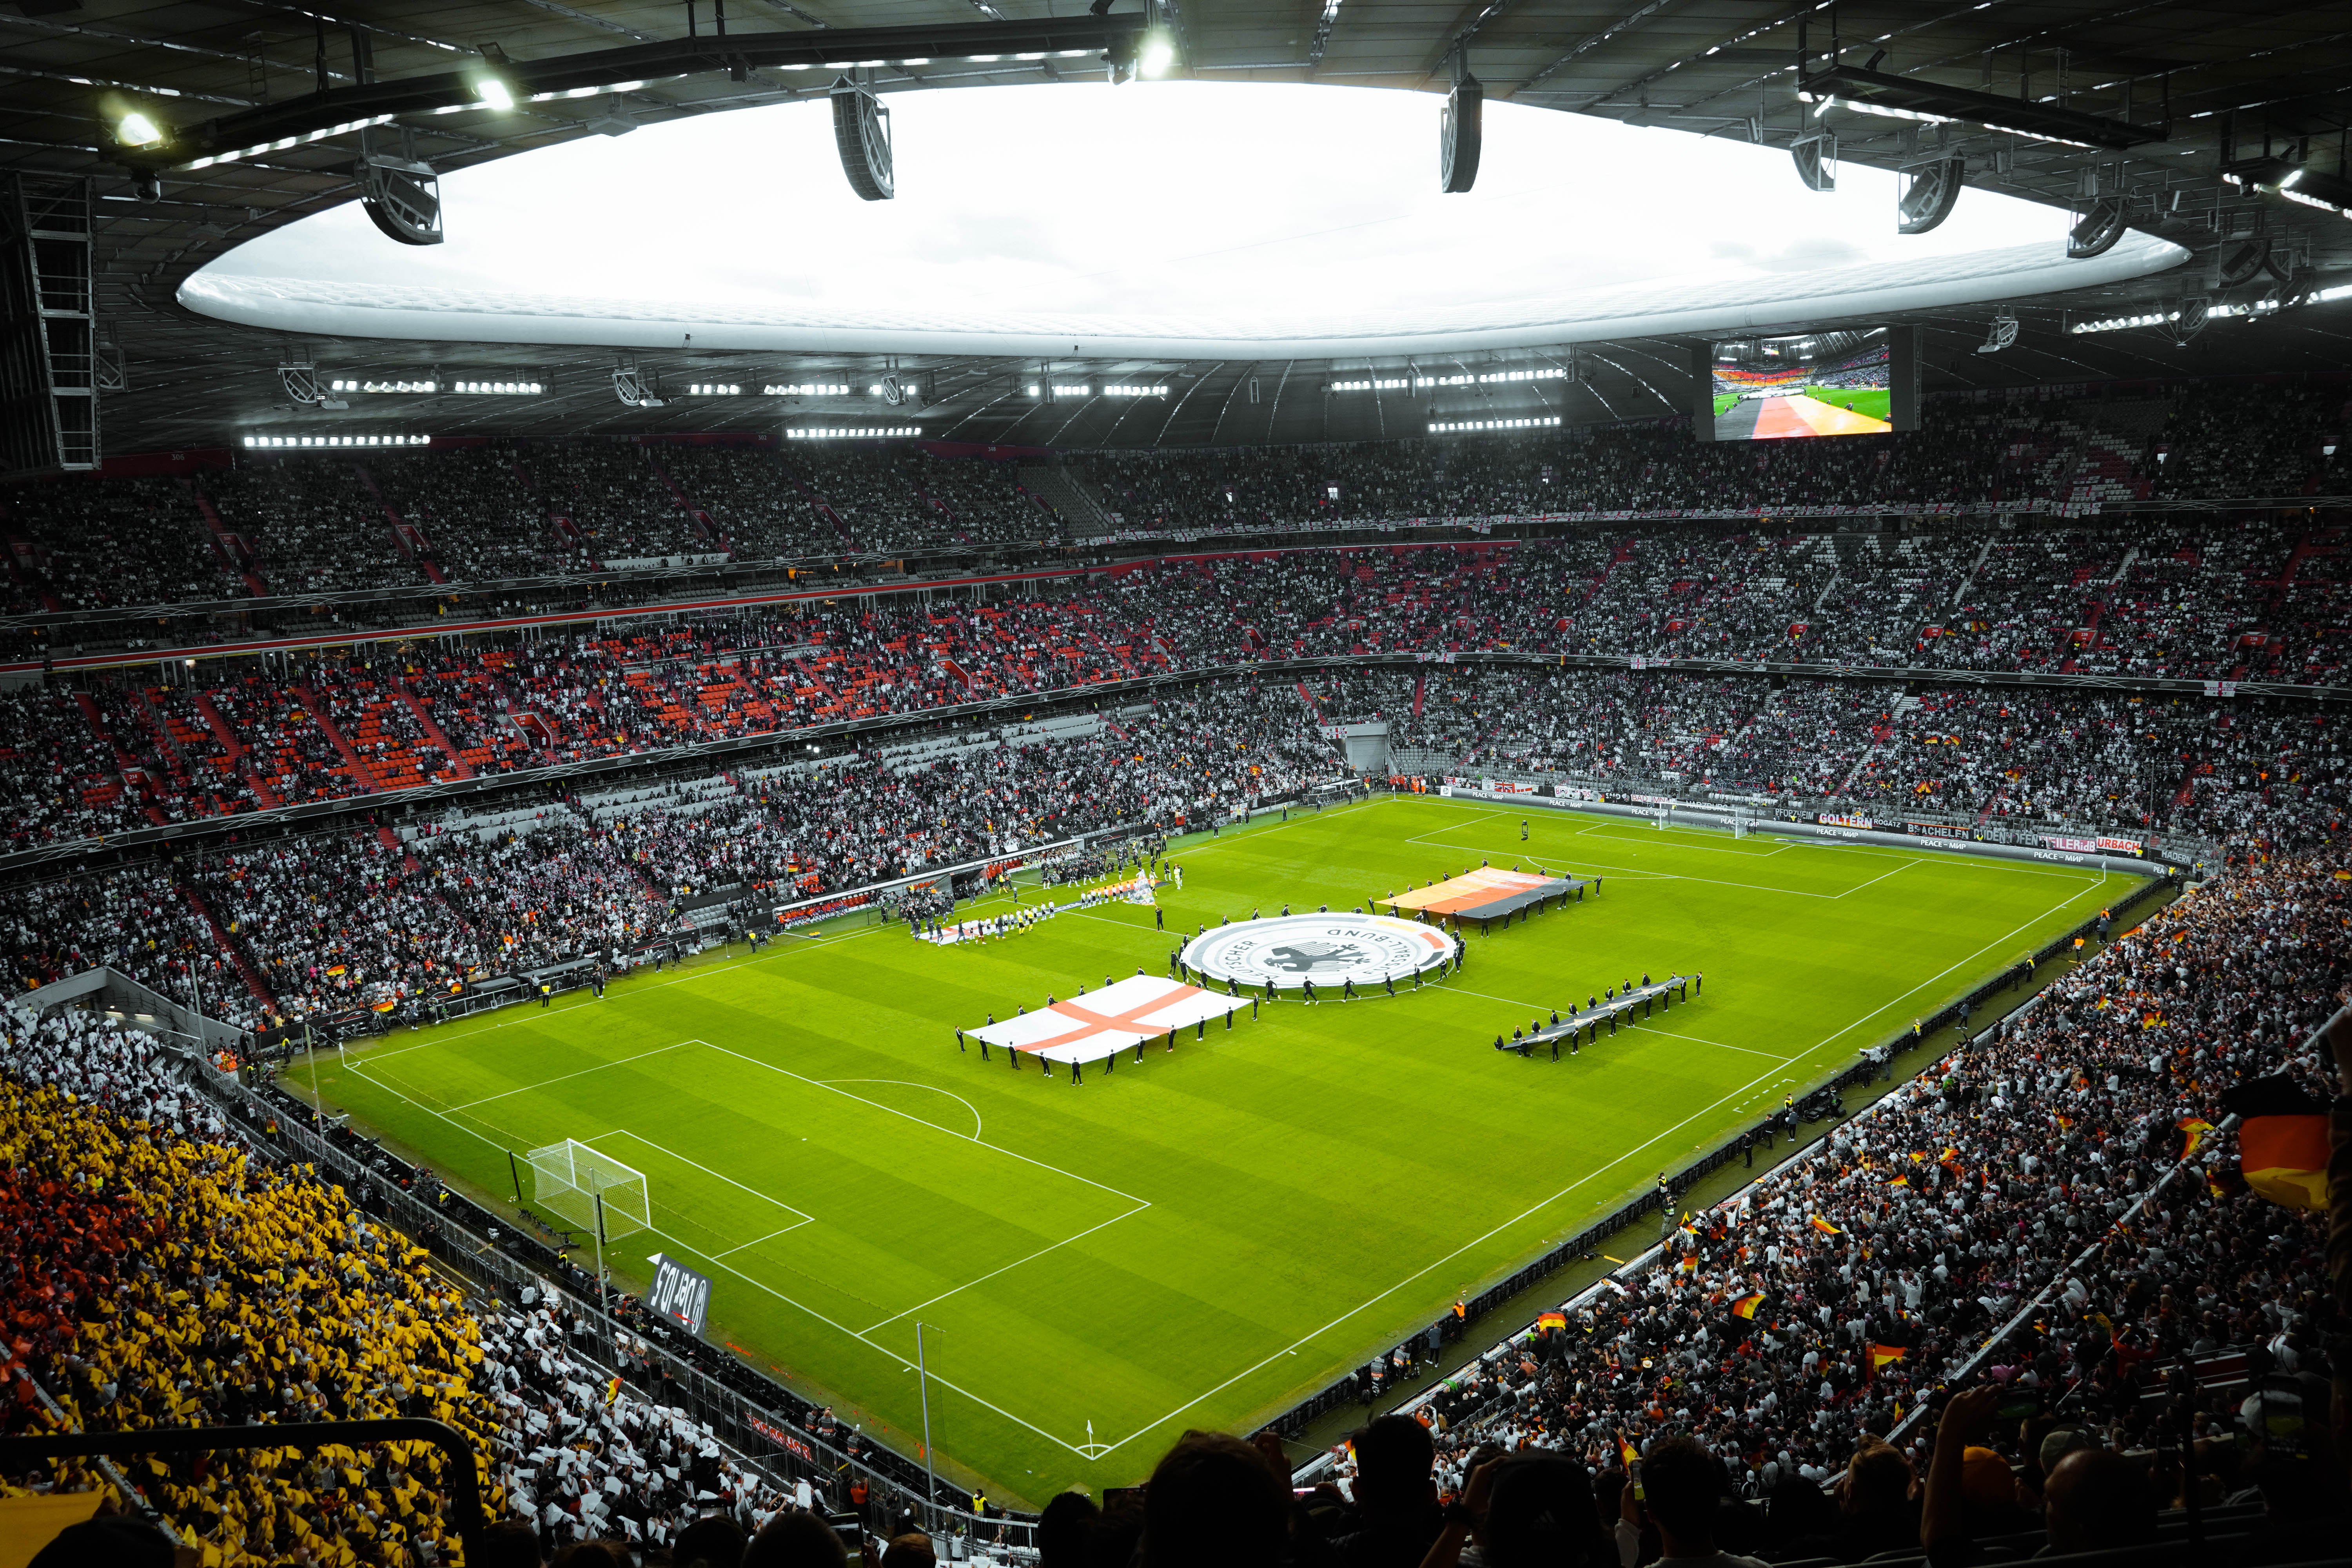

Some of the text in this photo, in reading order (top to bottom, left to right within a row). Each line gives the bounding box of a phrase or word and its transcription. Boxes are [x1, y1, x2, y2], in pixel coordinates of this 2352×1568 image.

[1819, 813, 1873, 828] GOLTERN
[1920, 839, 1966, 850] PEACE МИР
[2098, 838, 2140, 851] URBACH
[2034, 851, 2058, 860] PEACE
[2161, 850, 2192, 865] HADERN
[1224, 929, 1411, 979] DEUTSCHER FUSSBALL-BUND
